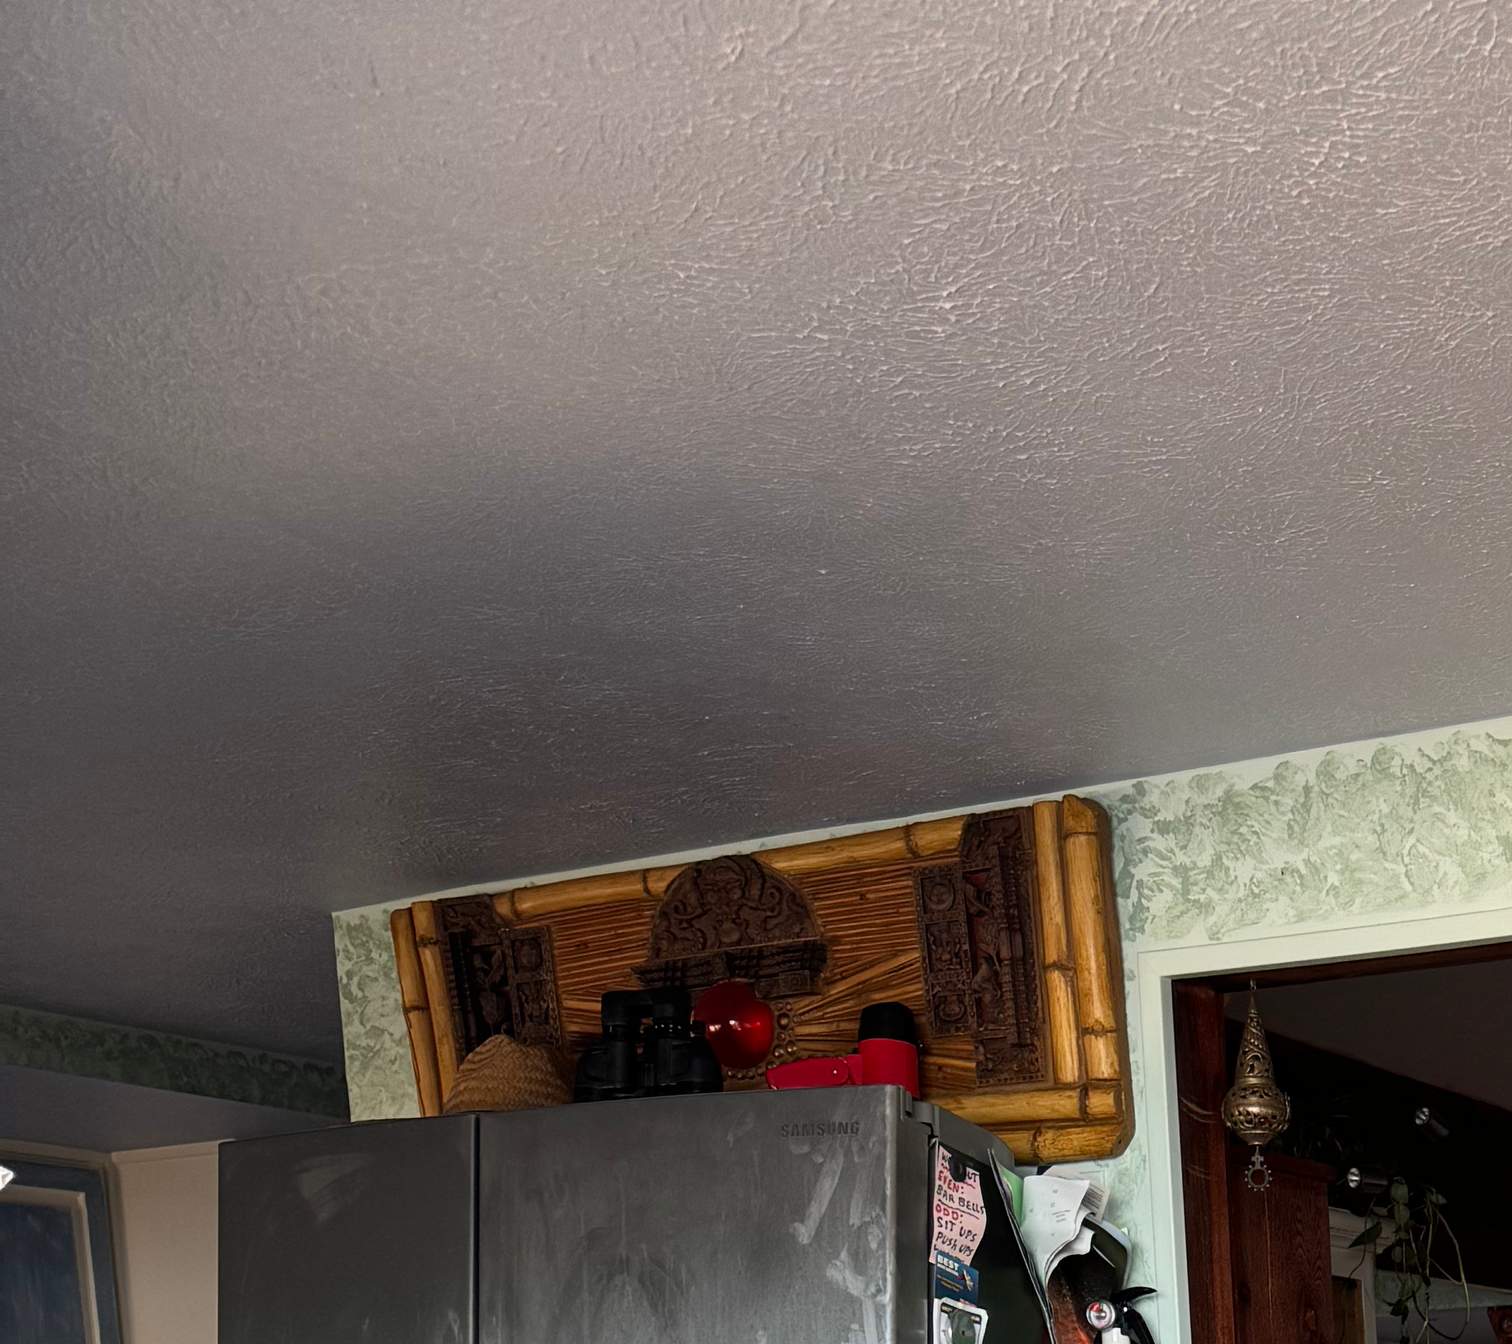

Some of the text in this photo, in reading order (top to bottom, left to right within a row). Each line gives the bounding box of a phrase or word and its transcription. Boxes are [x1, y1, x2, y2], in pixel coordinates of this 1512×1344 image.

[781, 1121, 860, 1137] SAMSUNG
[938, 1170, 964, 1194] EVEN:
[937, 1184, 985, 1214] BAR BELLS
[935, 1204, 963, 1223] ODD:
[937, 1217, 977, 1242] SIT UPS
[958, 1244, 974, 1257] UPS
[937, 1254, 959, 1271] BEST
